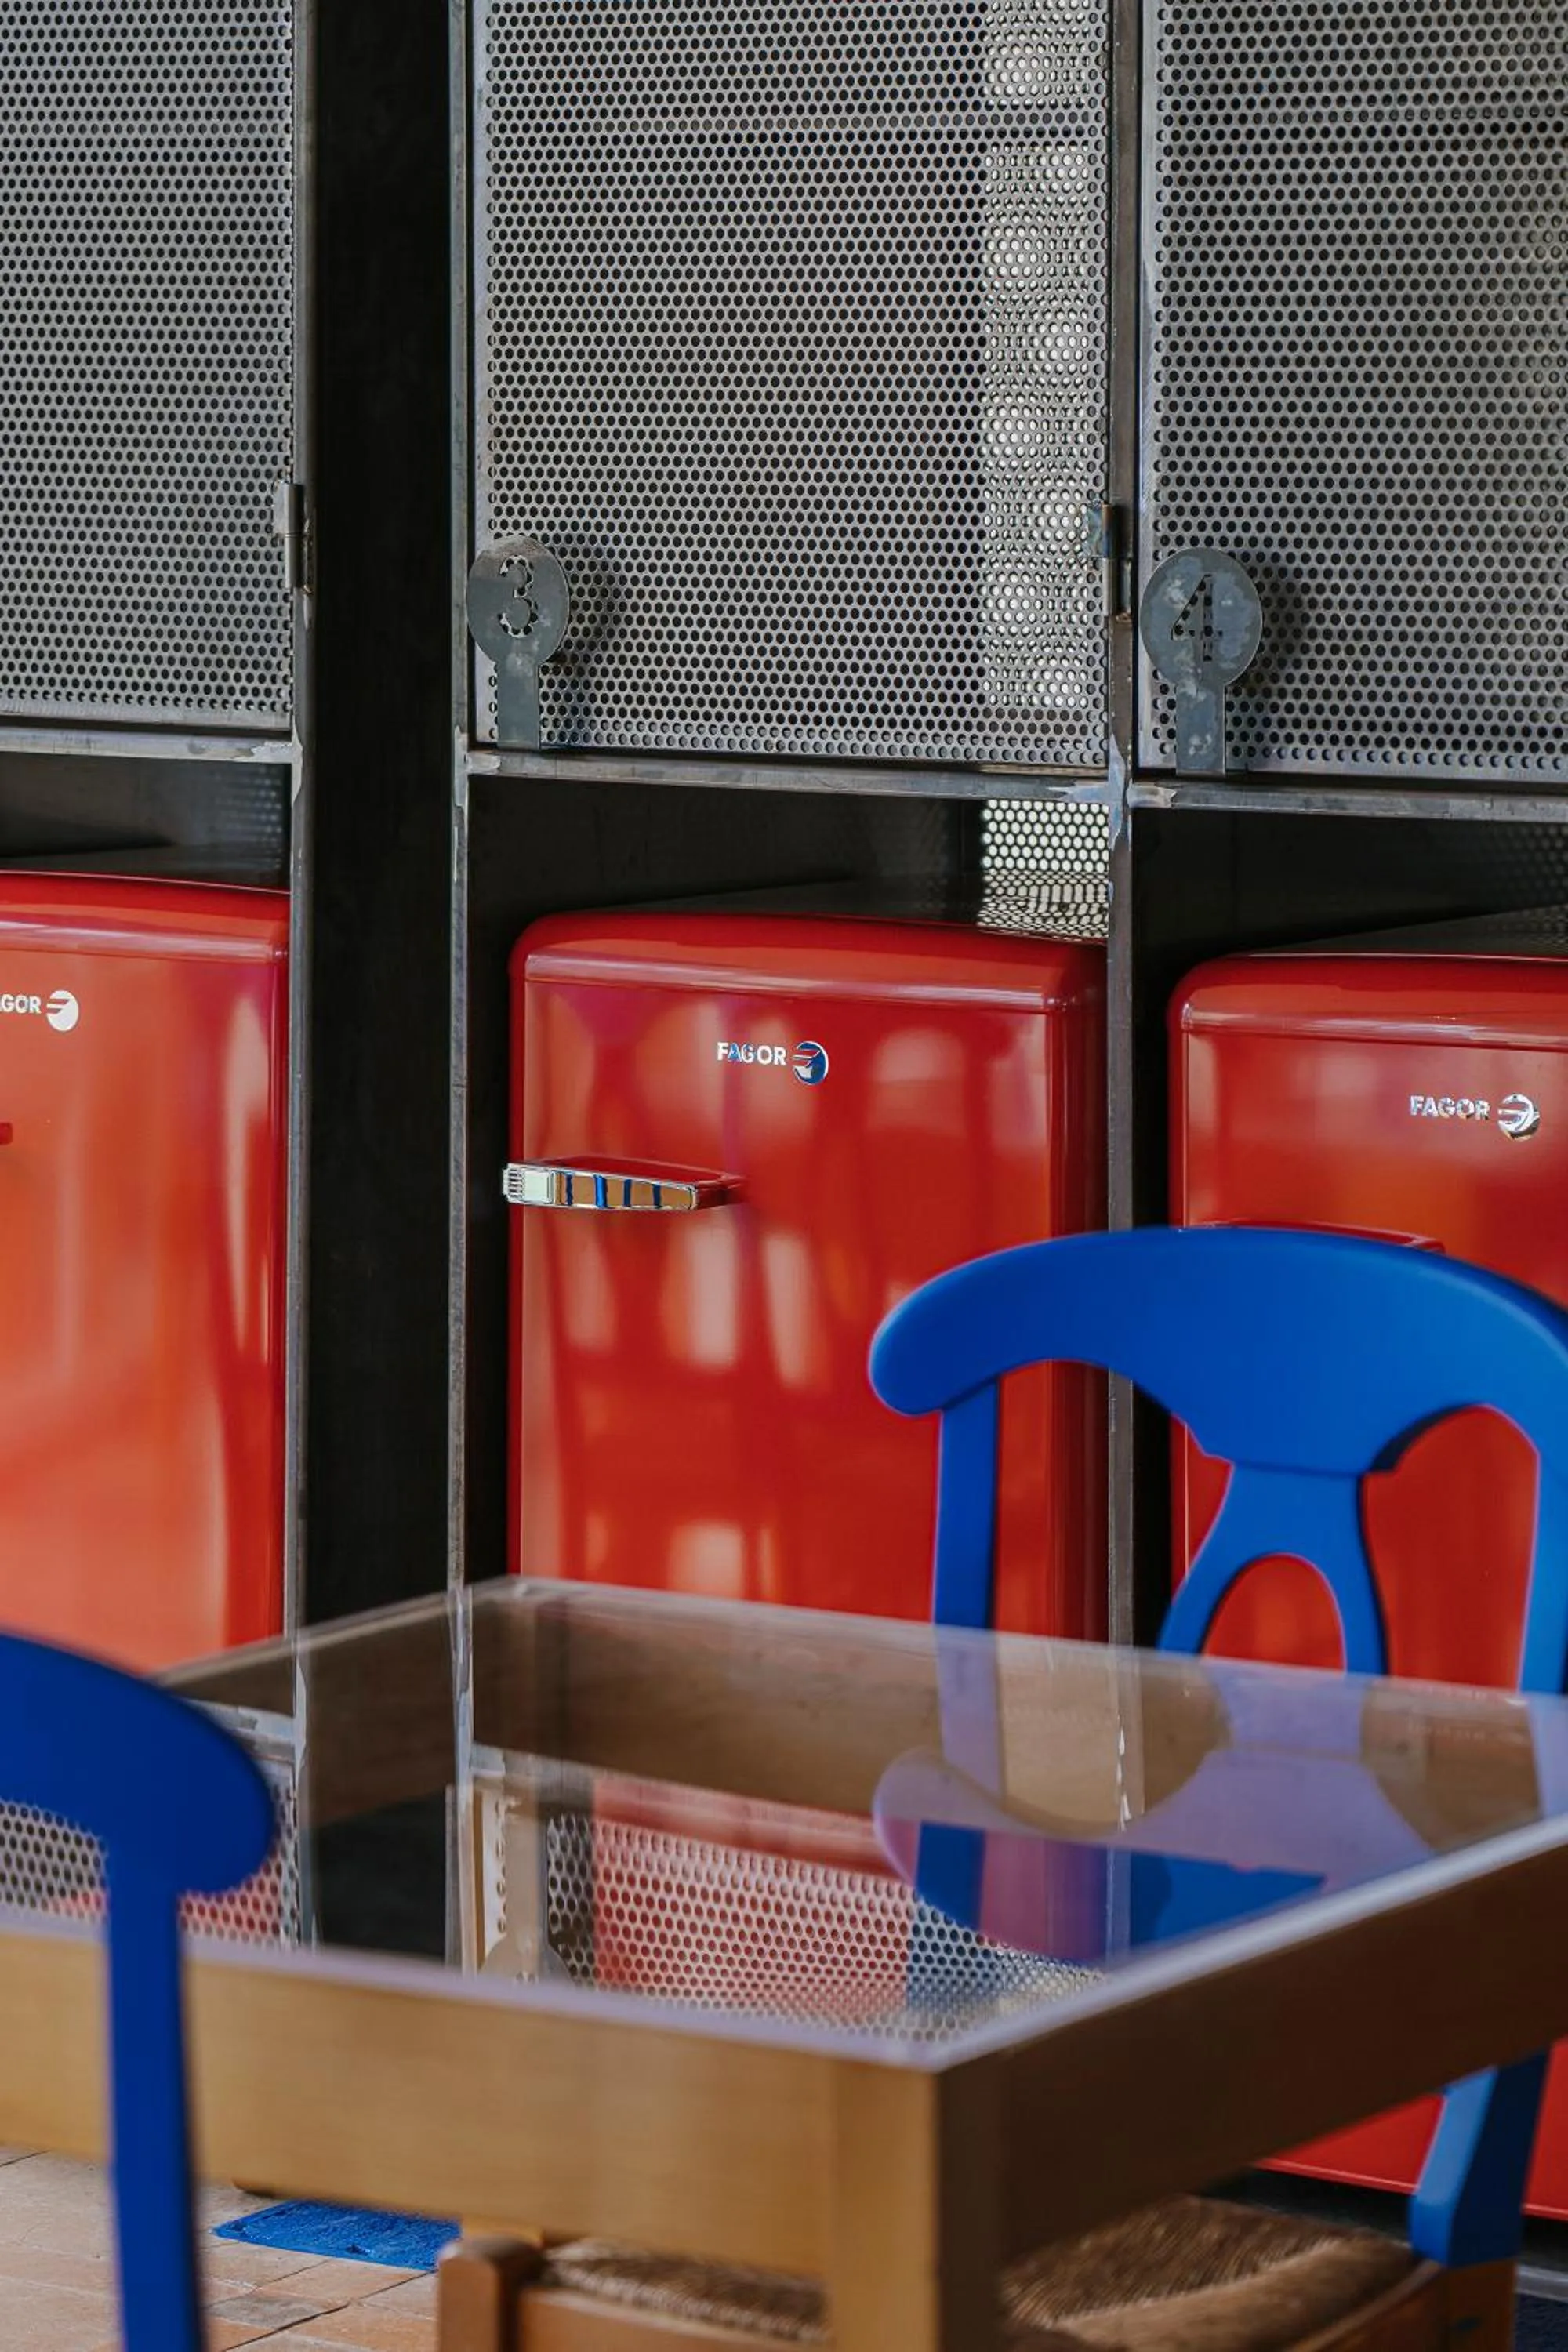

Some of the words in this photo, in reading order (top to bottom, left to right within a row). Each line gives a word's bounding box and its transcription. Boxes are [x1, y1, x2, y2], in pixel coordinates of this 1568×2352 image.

[498, 555, 538, 638] 3
[1171, 574, 1222, 662] 4
[0, 993, 42, 1014] GOR
[717, 1042, 787, 1066] FAGOR
[1410, 1095, 1490, 1120] FAGOR
